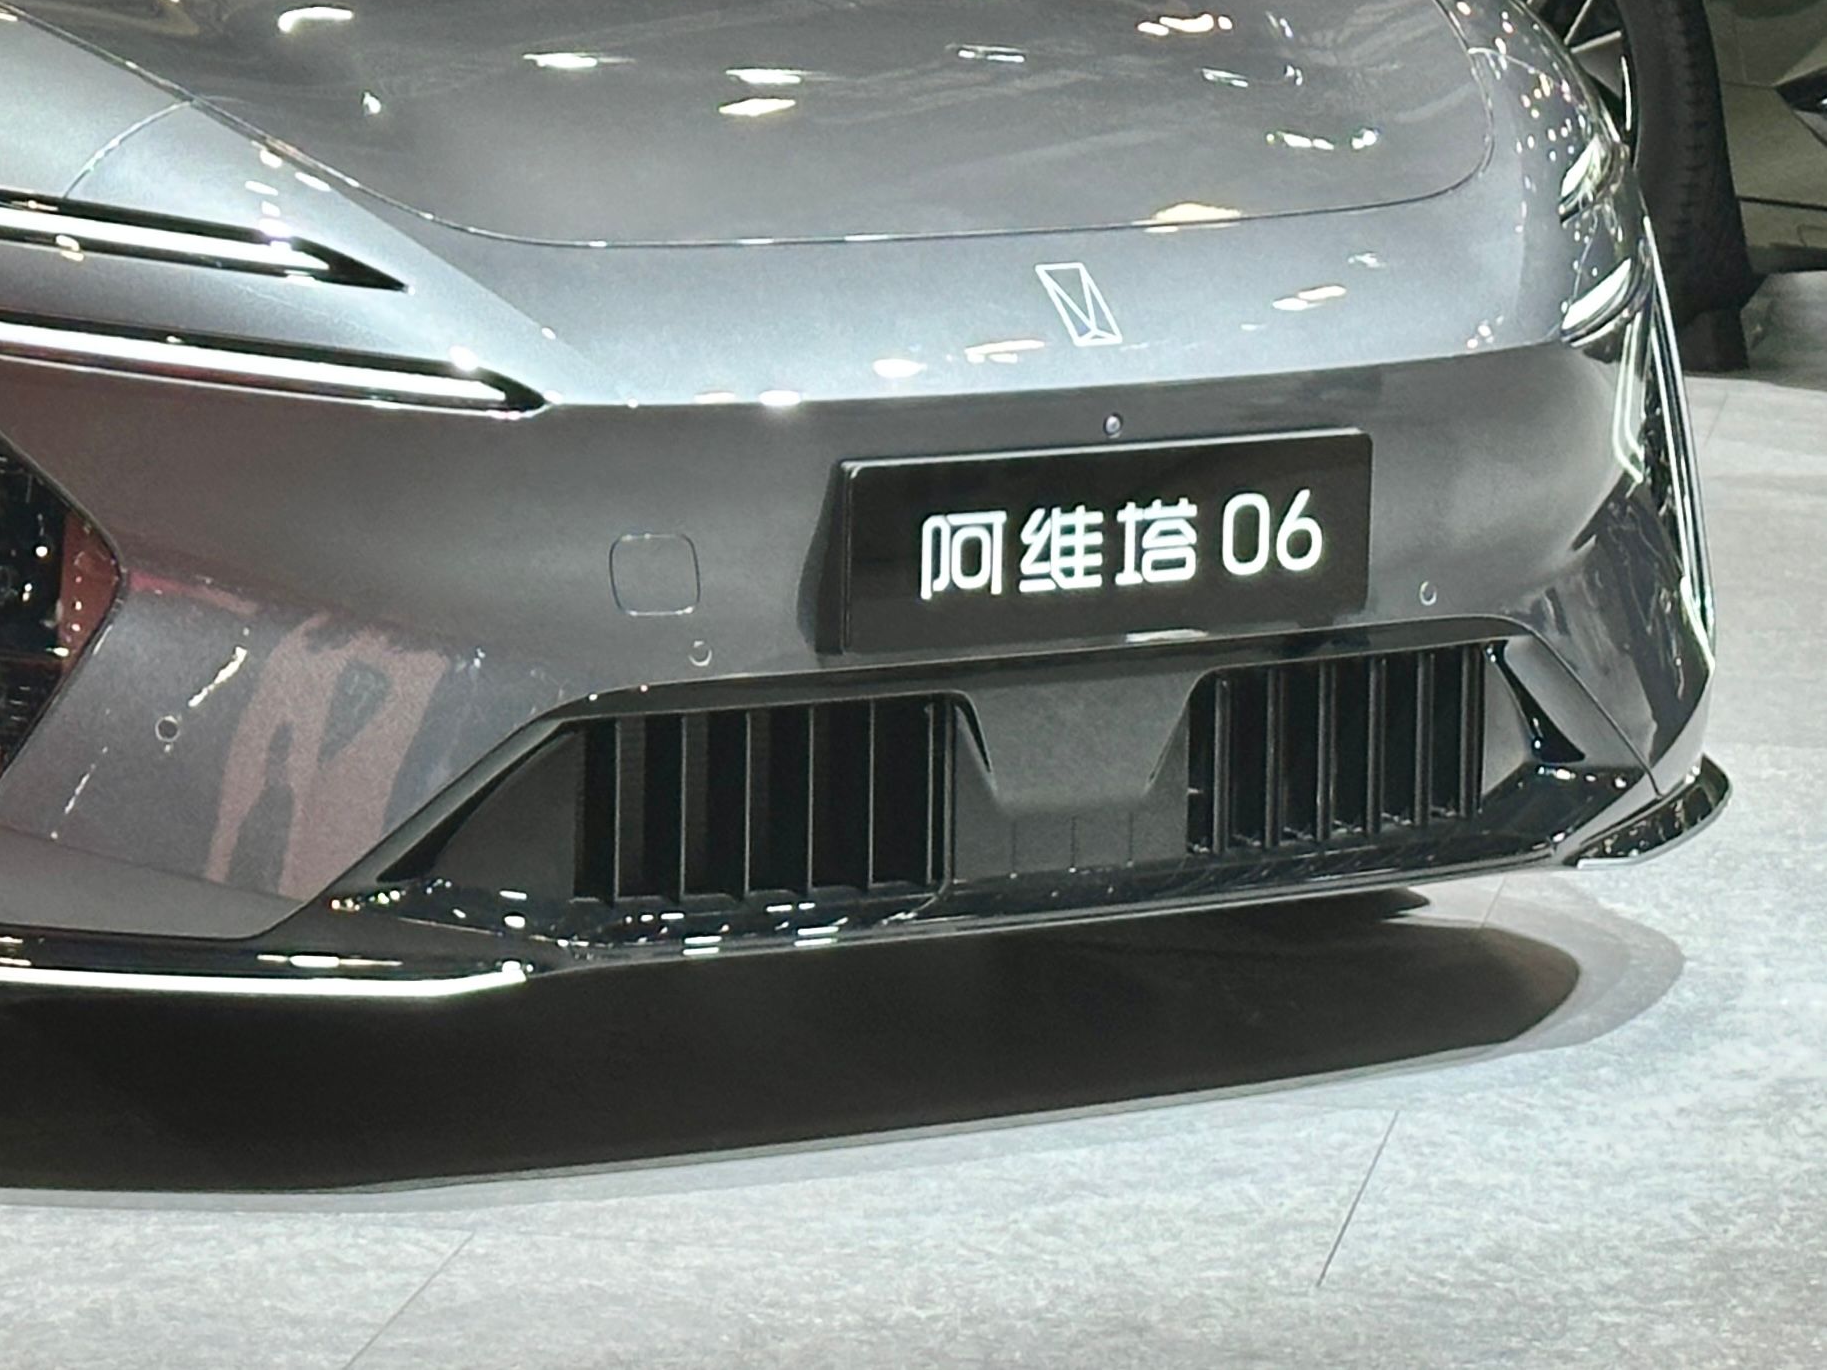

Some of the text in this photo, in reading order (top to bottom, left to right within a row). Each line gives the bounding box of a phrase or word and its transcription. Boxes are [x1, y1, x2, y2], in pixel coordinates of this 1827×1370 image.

[920, 488, 1324, 601] 阿维塔 06
